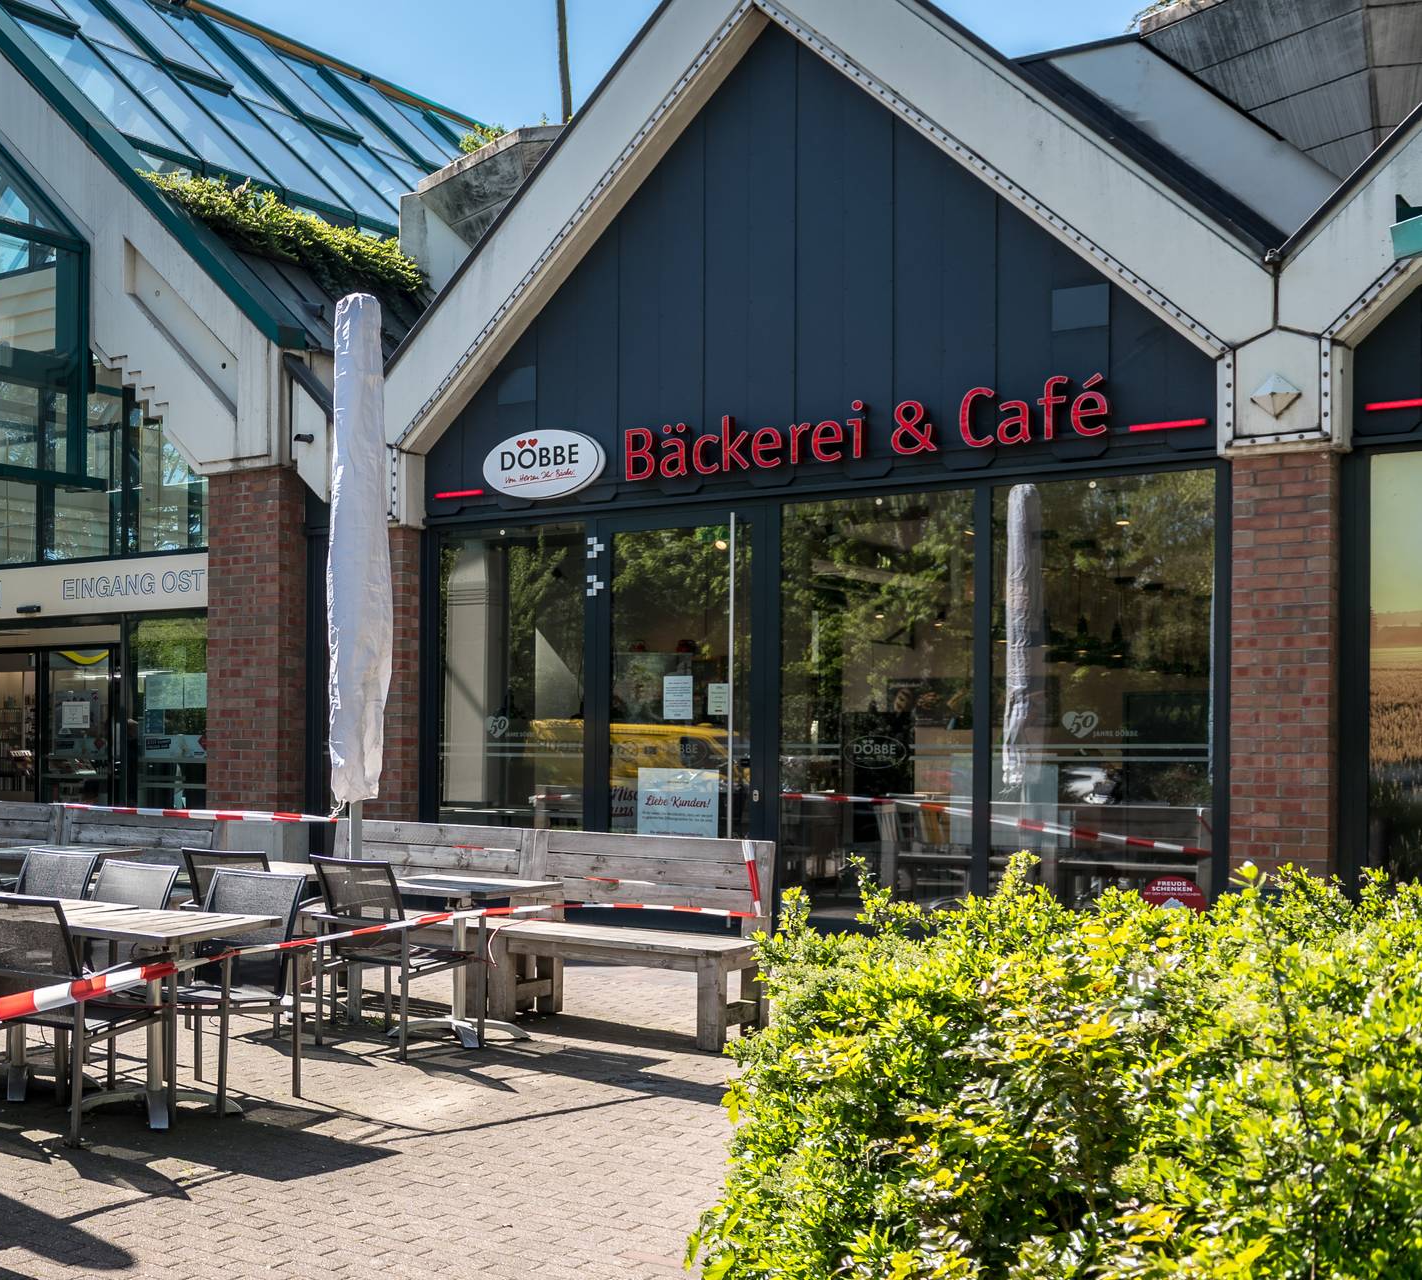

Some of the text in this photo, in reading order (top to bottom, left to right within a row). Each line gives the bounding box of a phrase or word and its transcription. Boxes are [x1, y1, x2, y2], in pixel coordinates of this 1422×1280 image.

[623, 372, 1109, 482] Bäckerei & Café
[500, 439, 579, 472] DÖBBE
[62, 569, 206, 600] EINGANG OST
[490, 719, 506, 735] 50
[1069, 714, 1095, 733] 50
[853, 741, 897, 755] DÖBBE
[645, 794, 712, 809] Liebe Kunden!
